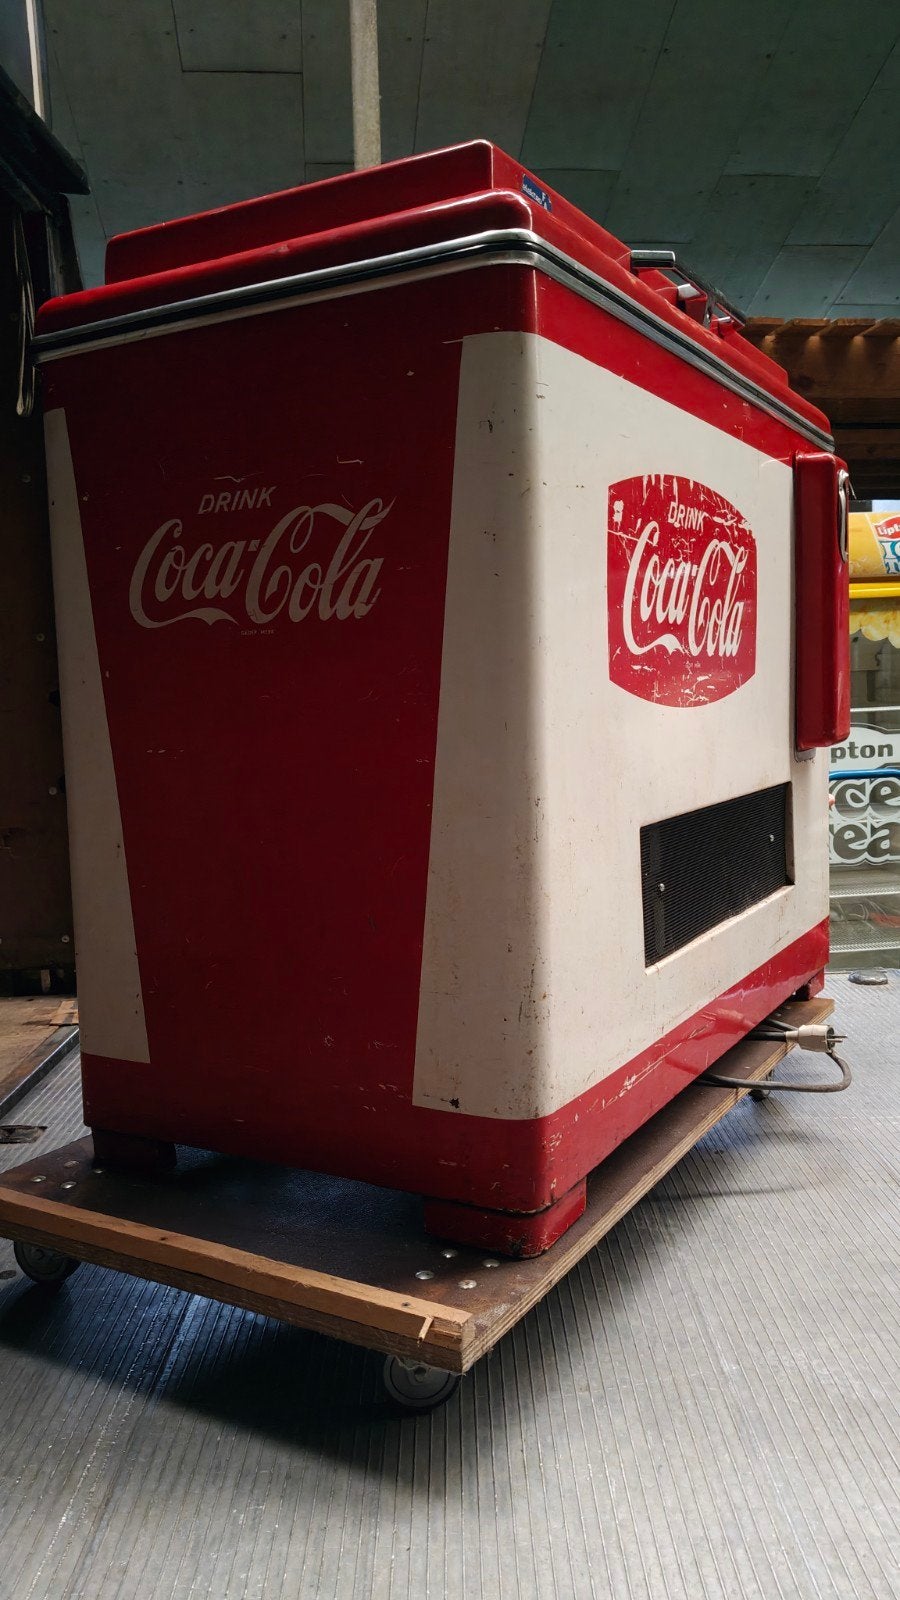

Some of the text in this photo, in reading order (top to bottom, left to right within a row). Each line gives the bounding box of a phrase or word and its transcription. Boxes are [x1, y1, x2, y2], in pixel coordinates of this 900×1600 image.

[197, 485, 277, 515] DRINK
[668, 501, 705, 532] DRINK
[877, 523, 900, 536] Lipt
[129, 496, 397, 628] Coca-Cola
[622, 520, 748, 657] Coca-Cola
[830, 741, 894, 763] pton
[829, 779, 900, 821] ce
[829, 822, 900, 863] ea
